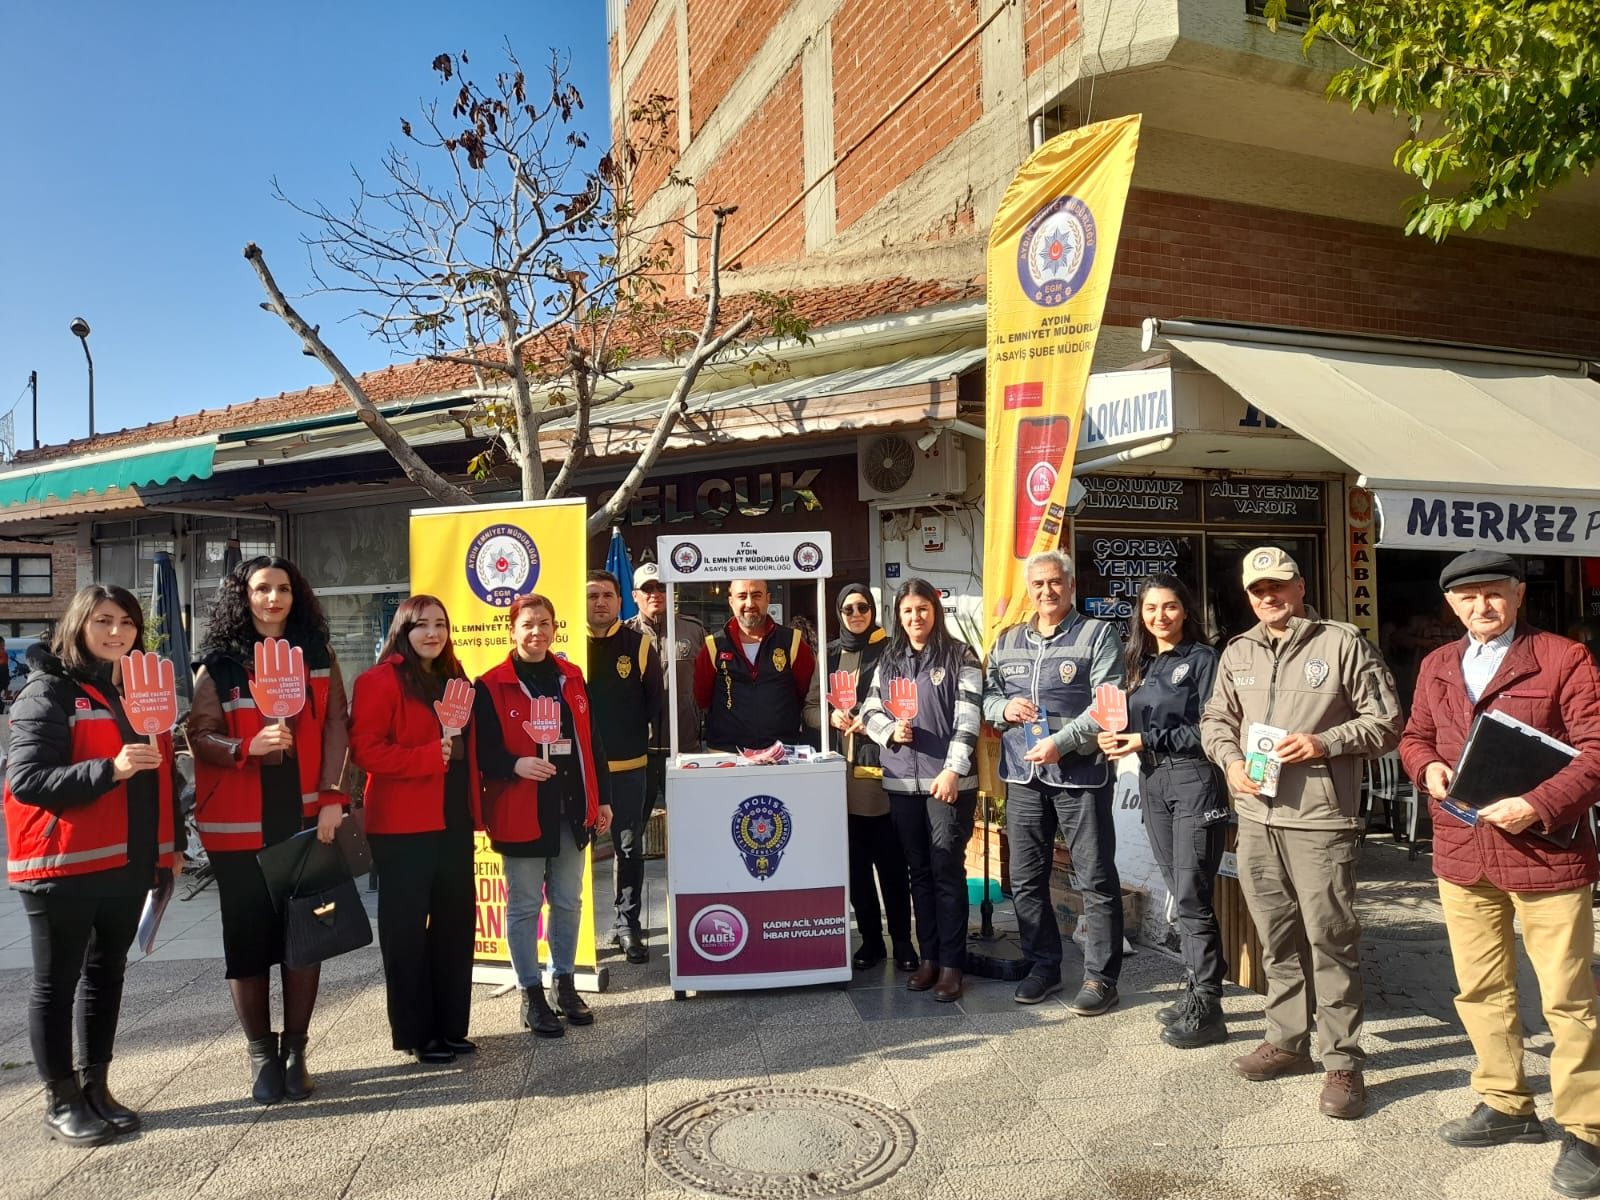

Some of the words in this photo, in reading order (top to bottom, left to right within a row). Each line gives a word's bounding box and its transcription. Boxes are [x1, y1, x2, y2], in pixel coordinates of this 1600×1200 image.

[1045, 283, 1063, 294] EGM
[1041, 314, 1071, 327] AYDIN
[996, 333, 1005, 345] İL
[1008, 328, 1051, 343] EMNİYET
[996, 348, 1027, 362] ASAYİŞ
[1029, 345, 1055, 359] ŞUBE
[1087, 389, 1168, 443] LOKANTA
[1082, 477, 1184, 494] ALONUMUZ
[1210, 481, 1249, 498] AİLE
[1254, 483, 1319, 500] YERİMİZ
[1085, 492, 1179, 511] LİMALIDIR
[1234, 499, 1297, 514] VARDIR
[1407, 497, 1578, 543] MERKEZ
[468, 546, 479, 569] AYDIN
[477, 527, 506, 545] EMNİYET
[1093, 538, 1178, 559] ÇORBA
[704, 556, 711, 564] İL
[712, 556, 743, 564] EMNİYET
[745, 555, 790, 563] MÜDÜRLÜĞÜ
[1094, 559, 1177, 577] YEMEK
[1353, 531, 1371, 617] KABAK
[452, 624, 459, 632] İL
[462, 623, 502, 632] EMNİYET
[453, 637, 482, 647] ASAYİŞ
[485, 637, 508, 647] ŞUBE
[743, 798, 780, 809] POLİS
[474, 861, 500, 875] DETİN
[478, 878, 509, 905] DIN
[763, 920, 790, 930] KADIN
[792, 917, 811, 927] ACİL
[813, 916, 845, 926] YARDIM
[702, 933, 736, 943] KADES
[763, 930, 789, 940] İHBAR
[790, 927, 845, 938] UYGULAMASI
[475, 941, 498, 954] DES
